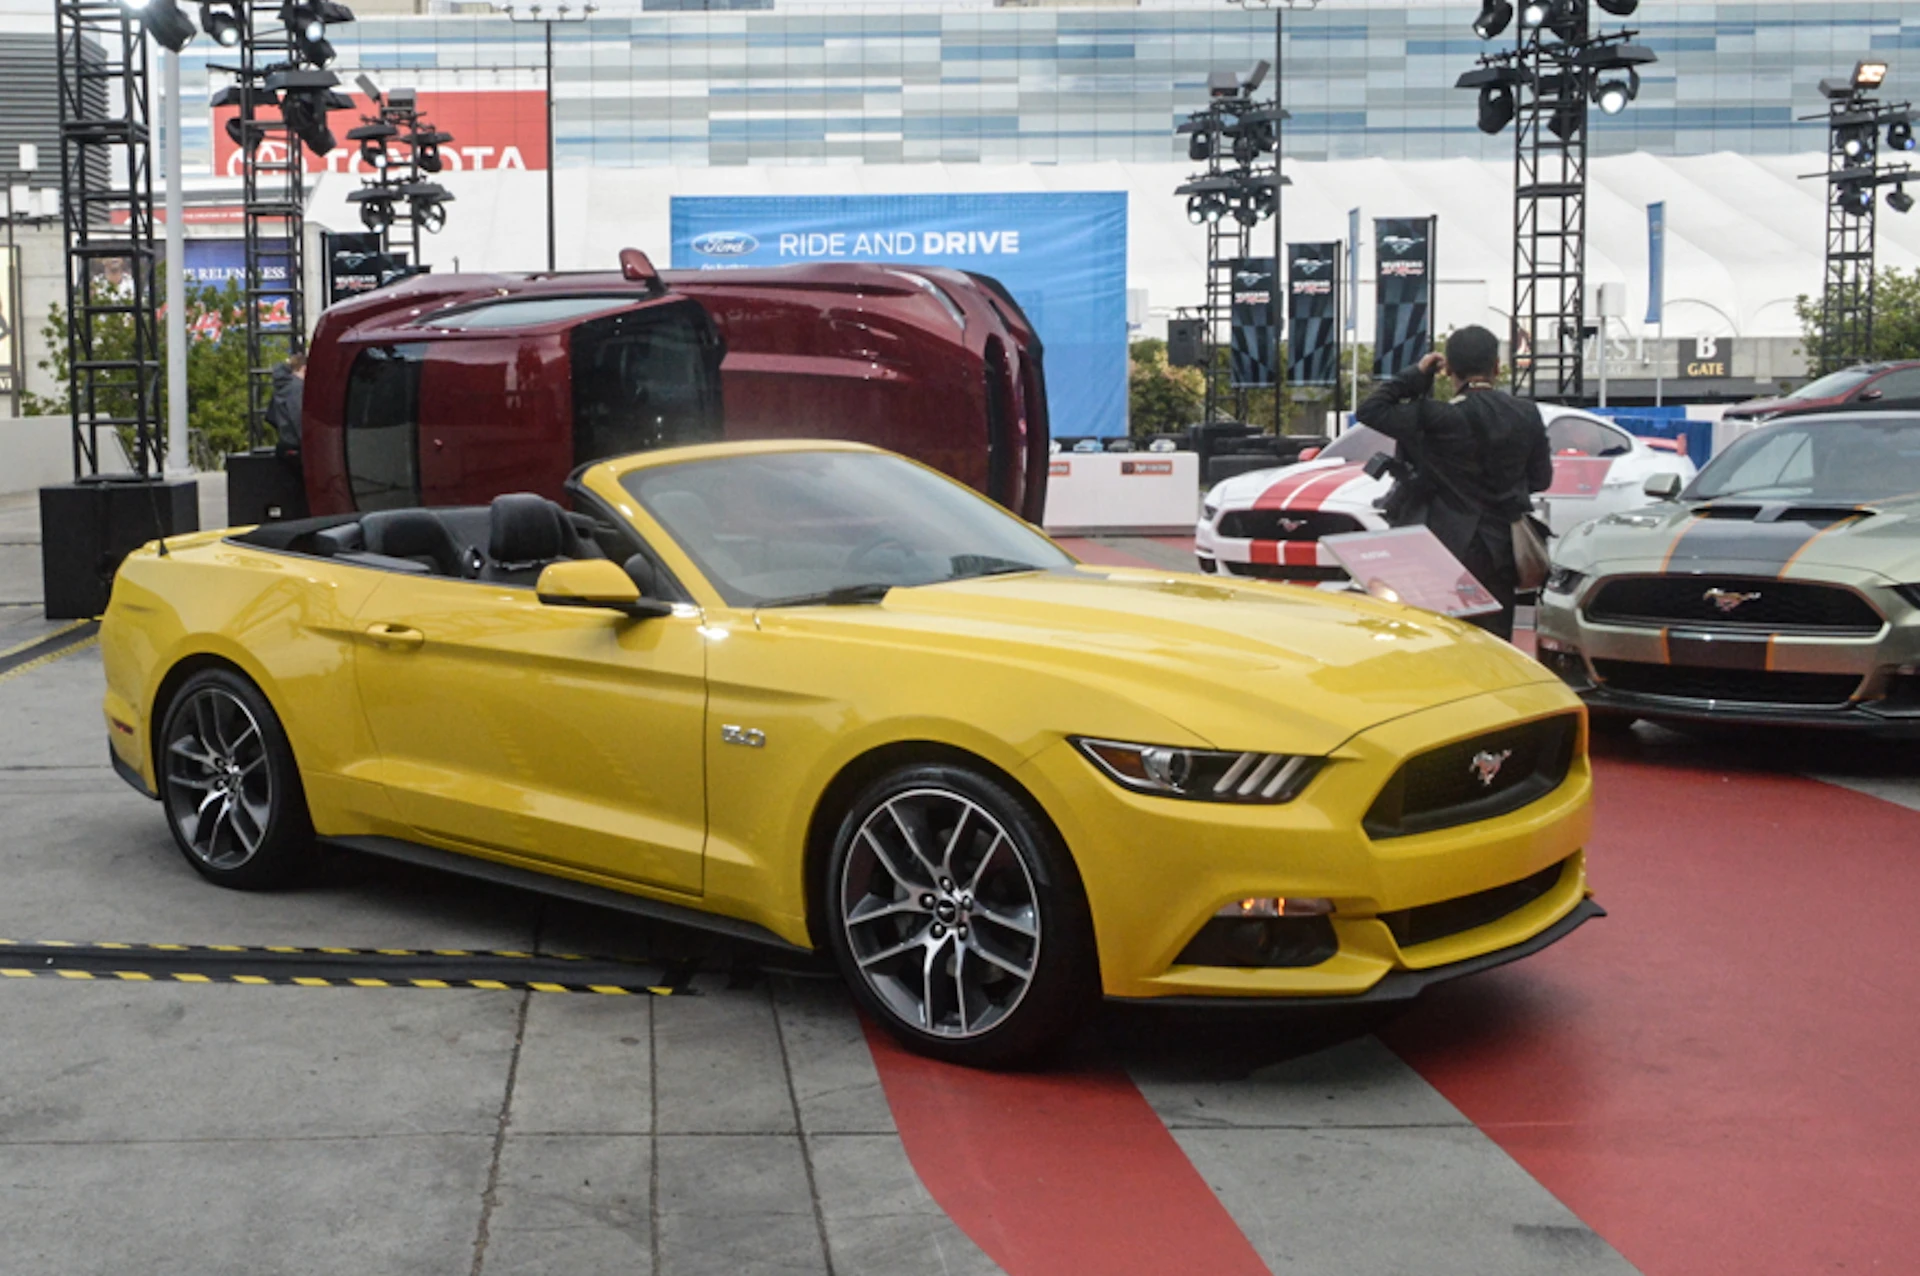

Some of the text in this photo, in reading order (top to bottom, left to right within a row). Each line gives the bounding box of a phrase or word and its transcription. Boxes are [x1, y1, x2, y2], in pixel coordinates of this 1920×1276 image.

[703, 235, 747, 253] Ford
[780, 231, 1020, 256] RIDE AND DRIVE
[198, 266, 286, 280] RELENESS
[1695, 335, 1718, 359] B
[1687, 363, 1725, 376] GATE
[722, 724, 766, 748] 5.0
